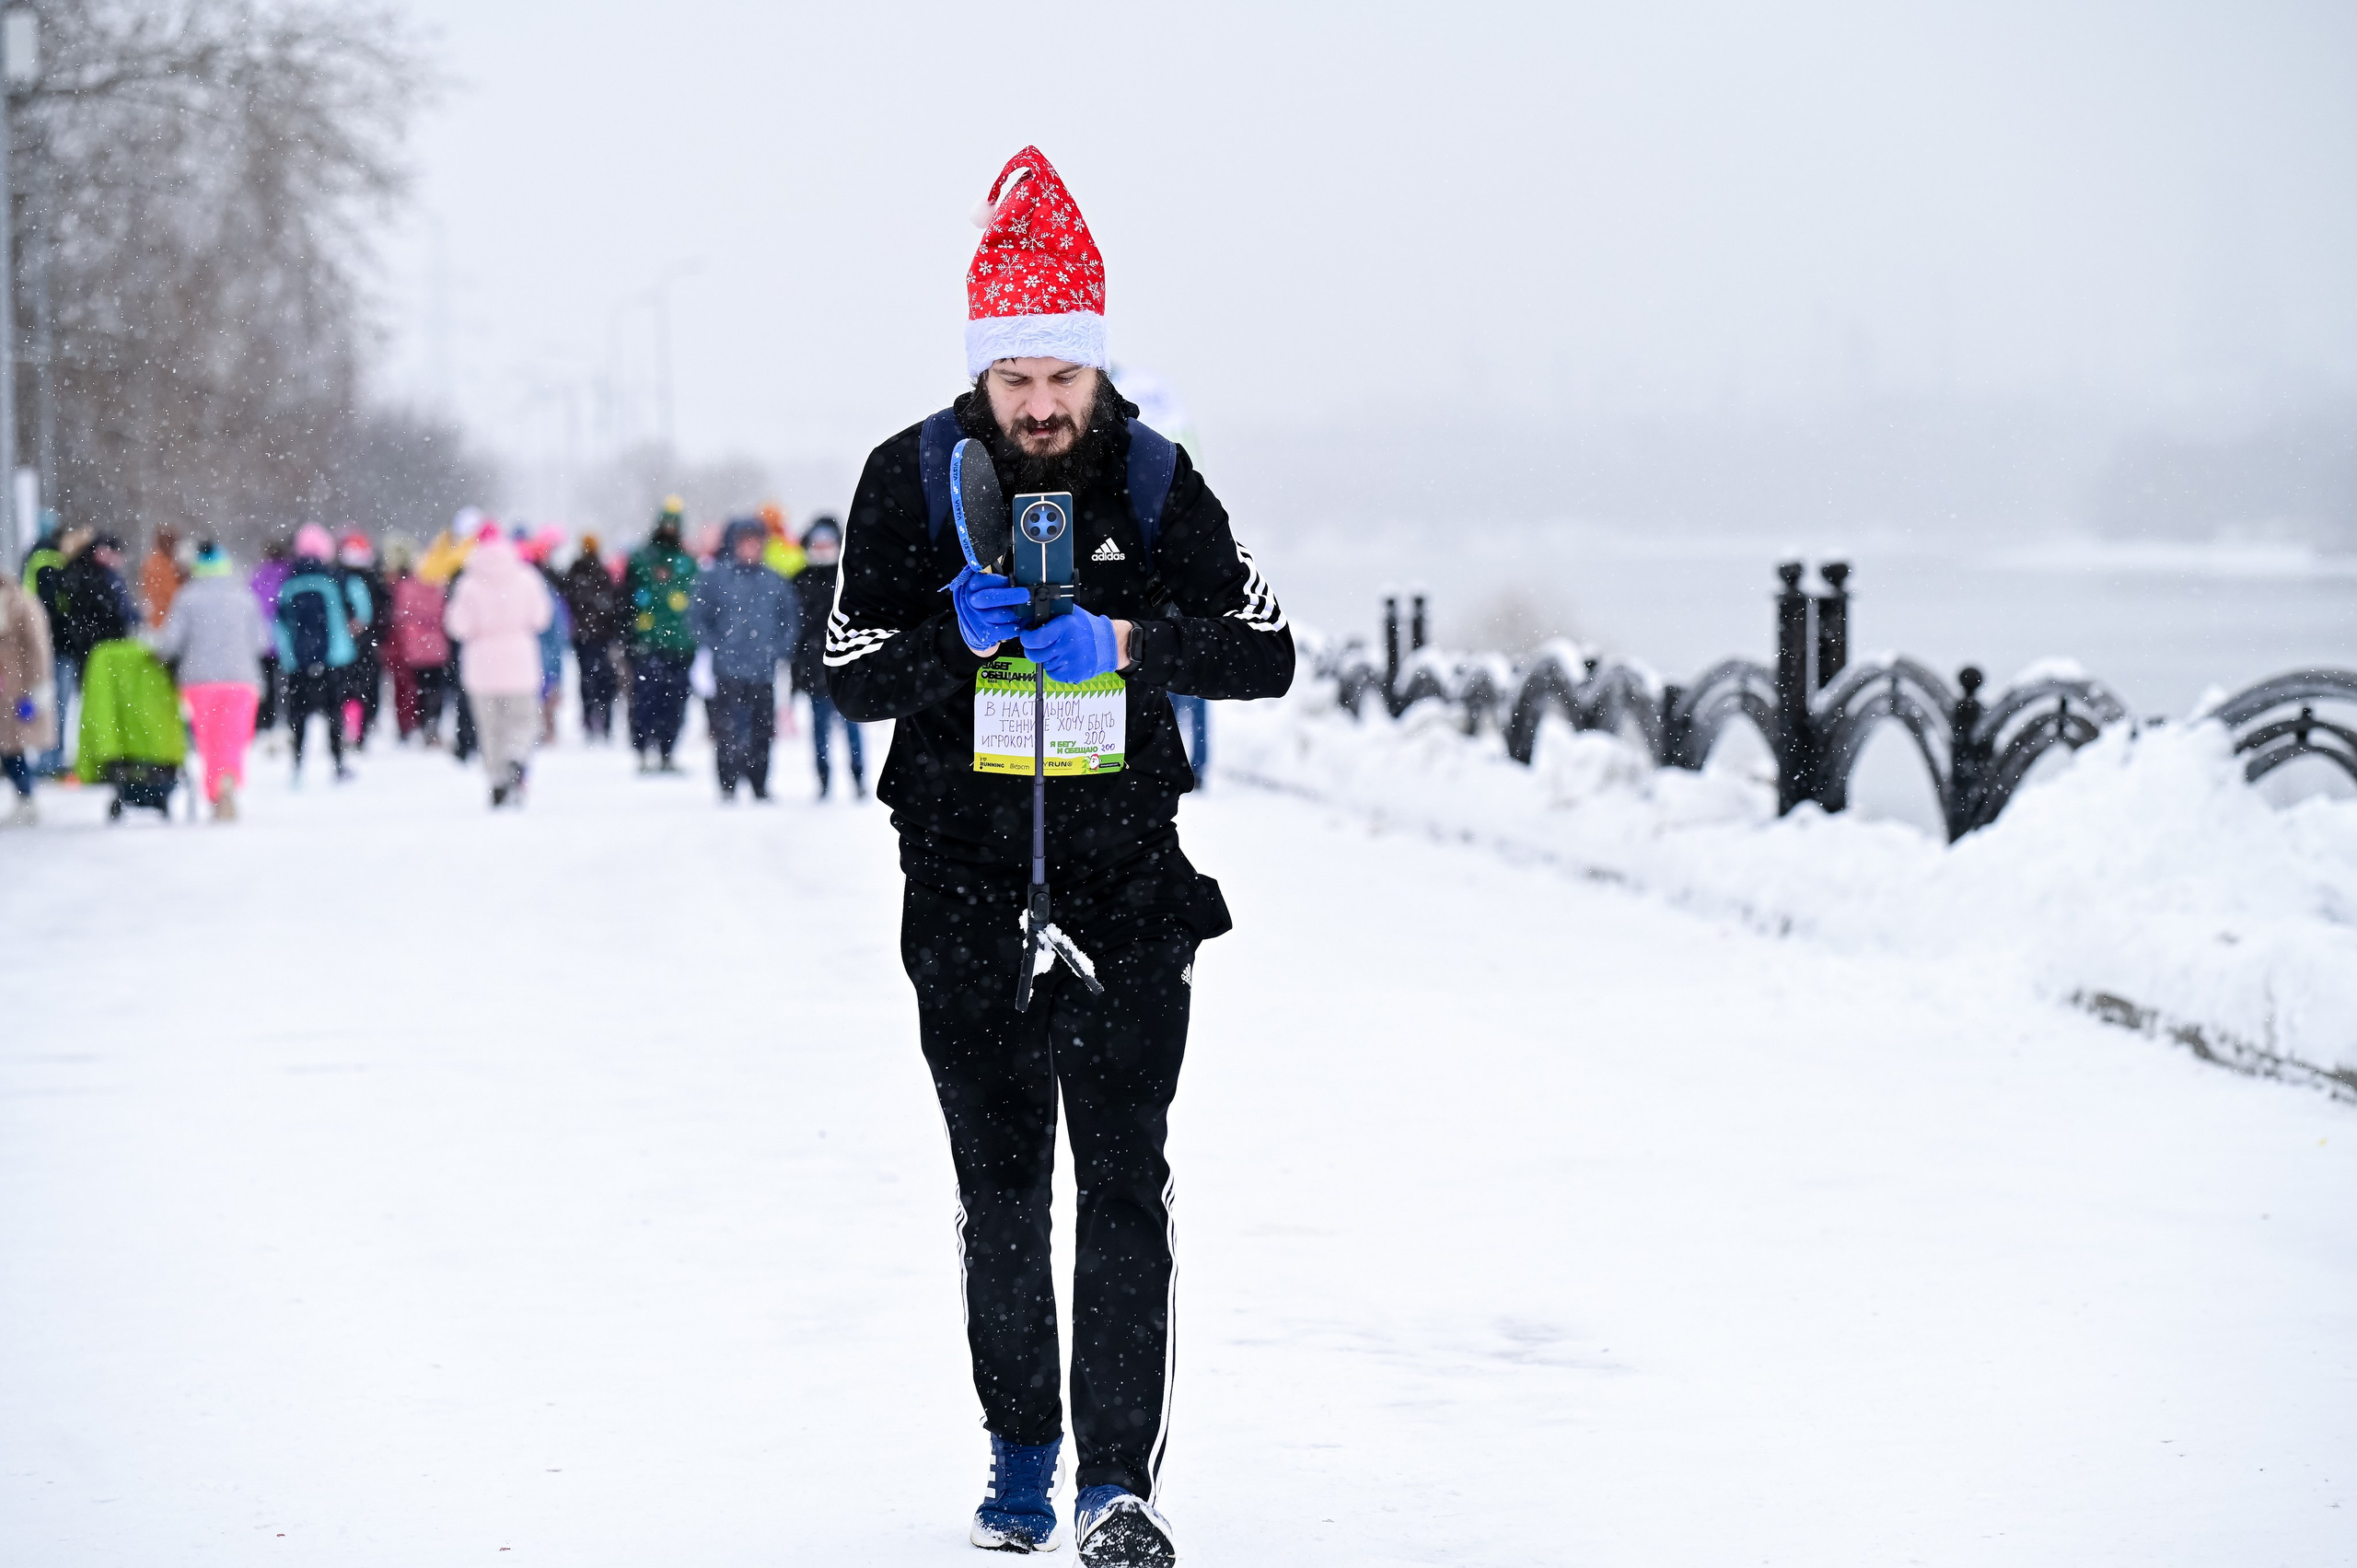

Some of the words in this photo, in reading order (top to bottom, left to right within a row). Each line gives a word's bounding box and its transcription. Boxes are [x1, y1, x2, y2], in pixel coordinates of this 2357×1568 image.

[963, 539, 972, 557] VISTA
[1091, 552, 1125, 562] adidas
[984, 701, 995, 716] В
[1002, 700, 1080, 719] НАСТЛЬНОМ
[999, 718, 1050, 734] ТЕННИЕ
[1058, 715, 1085, 731] ХОЧУ
[1087, 712, 1115, 731] БЫТЬ
[981, 735, 1033, 748] ИГРОКОМ
[1084, 729, 1106, 745] 200
[1064, 746, 1098, 754] ОБЕЩАЮ
[1100, 743, 1115, 752] 200
